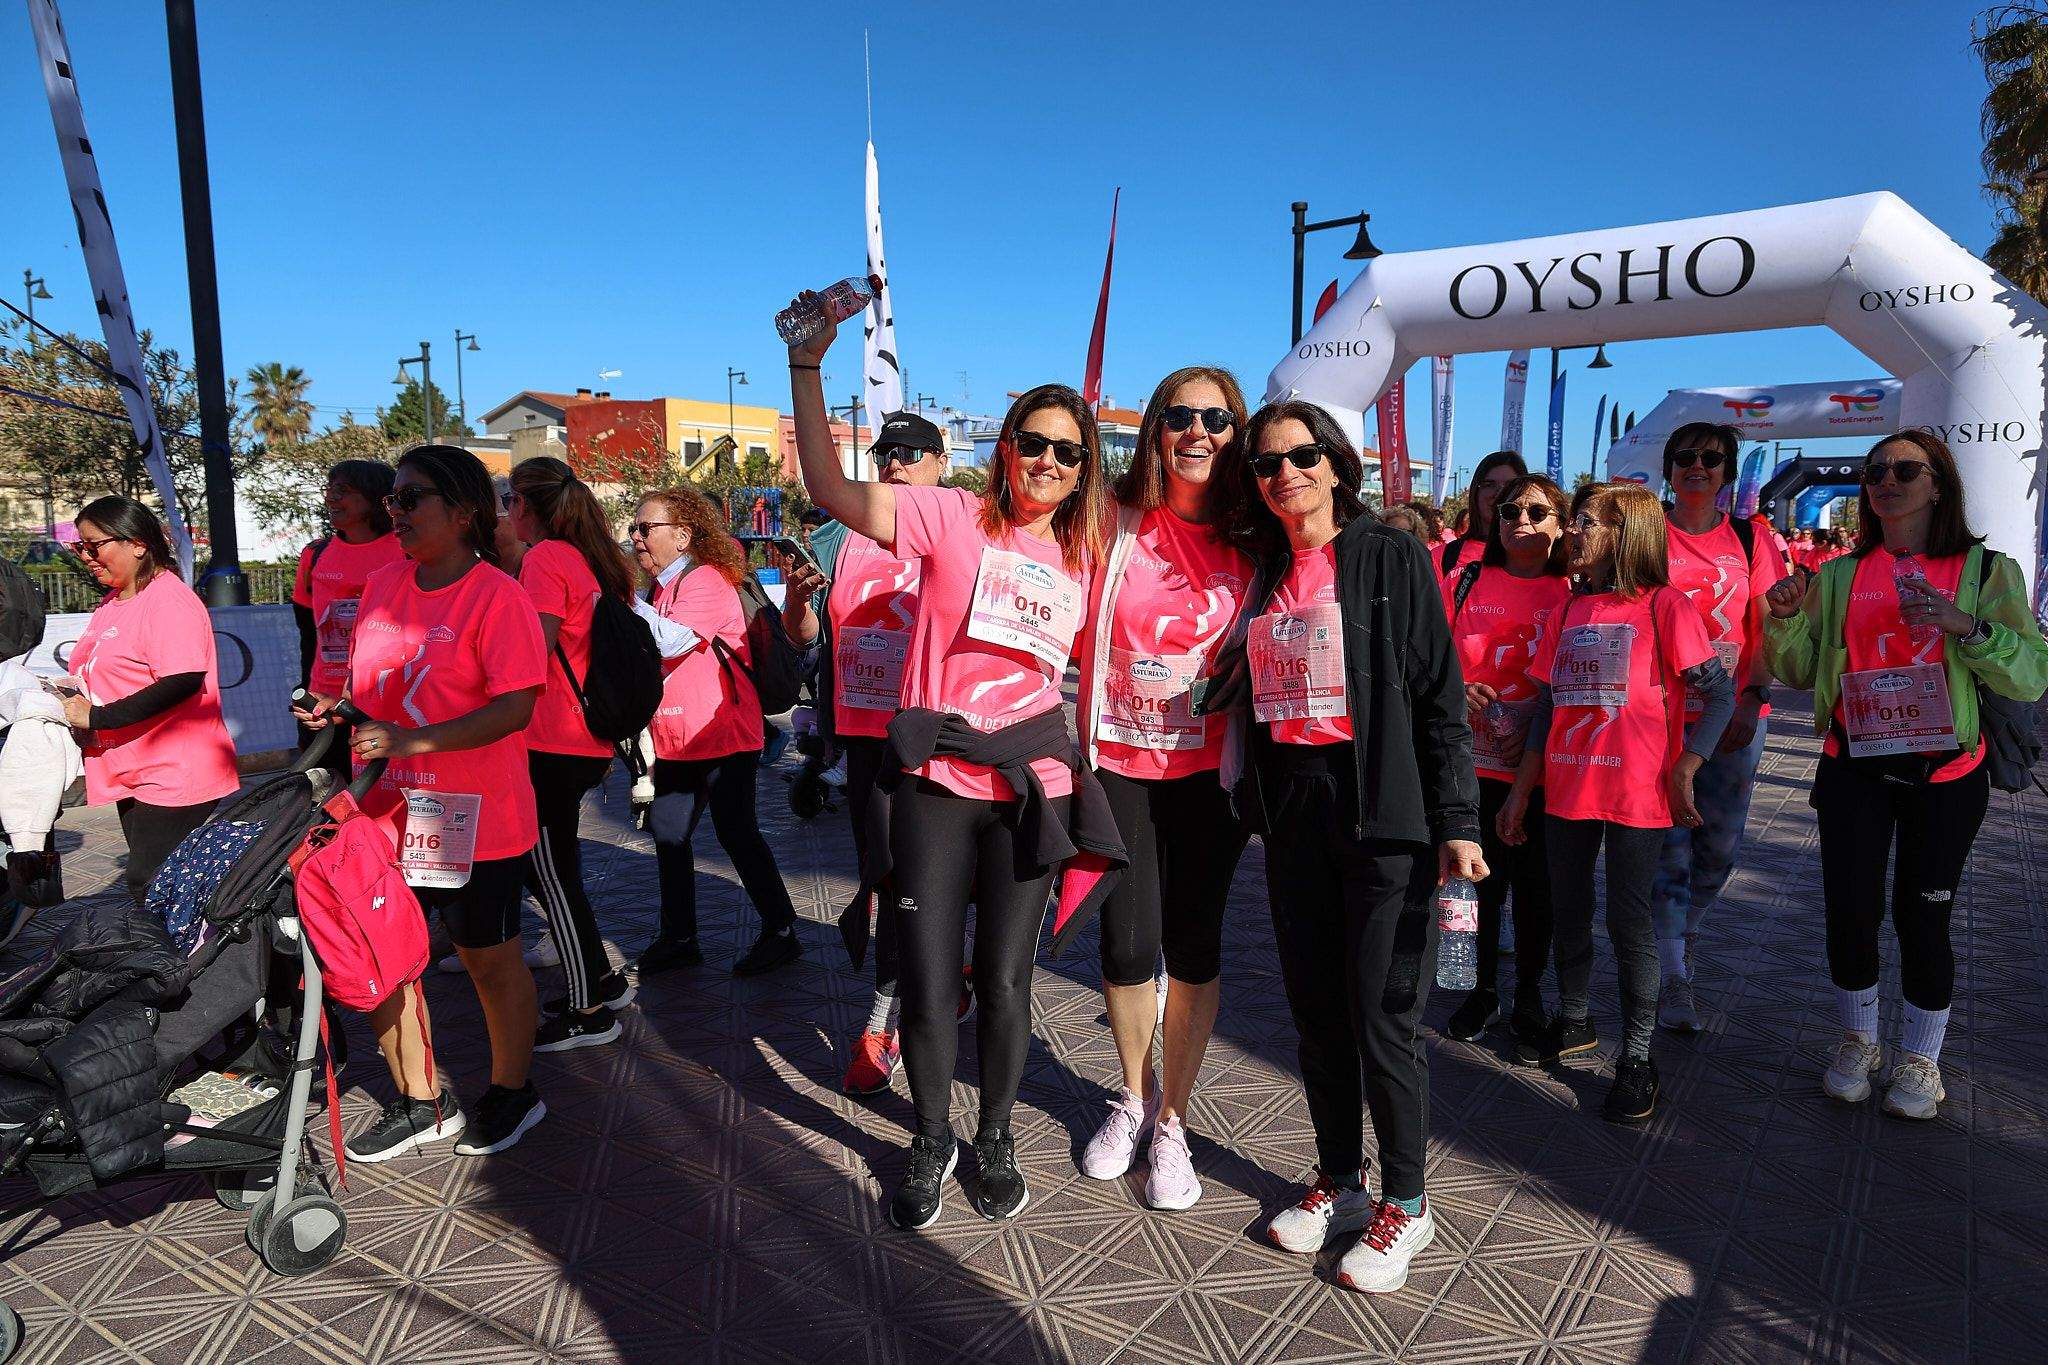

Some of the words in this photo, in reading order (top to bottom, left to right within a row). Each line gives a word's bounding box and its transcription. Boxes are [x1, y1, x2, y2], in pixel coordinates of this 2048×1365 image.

[1449, 236, 1756, 320] OYSHO
[1859, 282, 1975, 312] OYSHO
[1298, 340, 1371, 360] OYSHO
[1131, 553, 1175, 574] OYSHO
[1851, 591, 1884, 601] YSHO
[1015, 596, 1052, 622] 016
[1470, 605, 1506, 615] OYSHO
[367, 620, 402, 633] OYSHO
[1020, 615, 1039, 628] 5445
[855, 664, 885, 679] 016
[1131, 666, 1169, 678] ASTURIANA
[1275, 657, 1308, 678] 016
[1571, 660, 1600, 674] 016
[1874, 679, 1912, 689] ASTURIANA
[1132, 695, 1171, 714] 016
[1879, 704, 1920, 720] 016
[1140, 716, 1155, 724] 943
[1110, 728, 1140, 741] OYSHO
[1860, 742, 1893, 752] OYSHO
[1590, 755, 1622, 768] MUJER
[408, 803, 443, 814] STURIANA
[404, 833, 440, 849] 016
